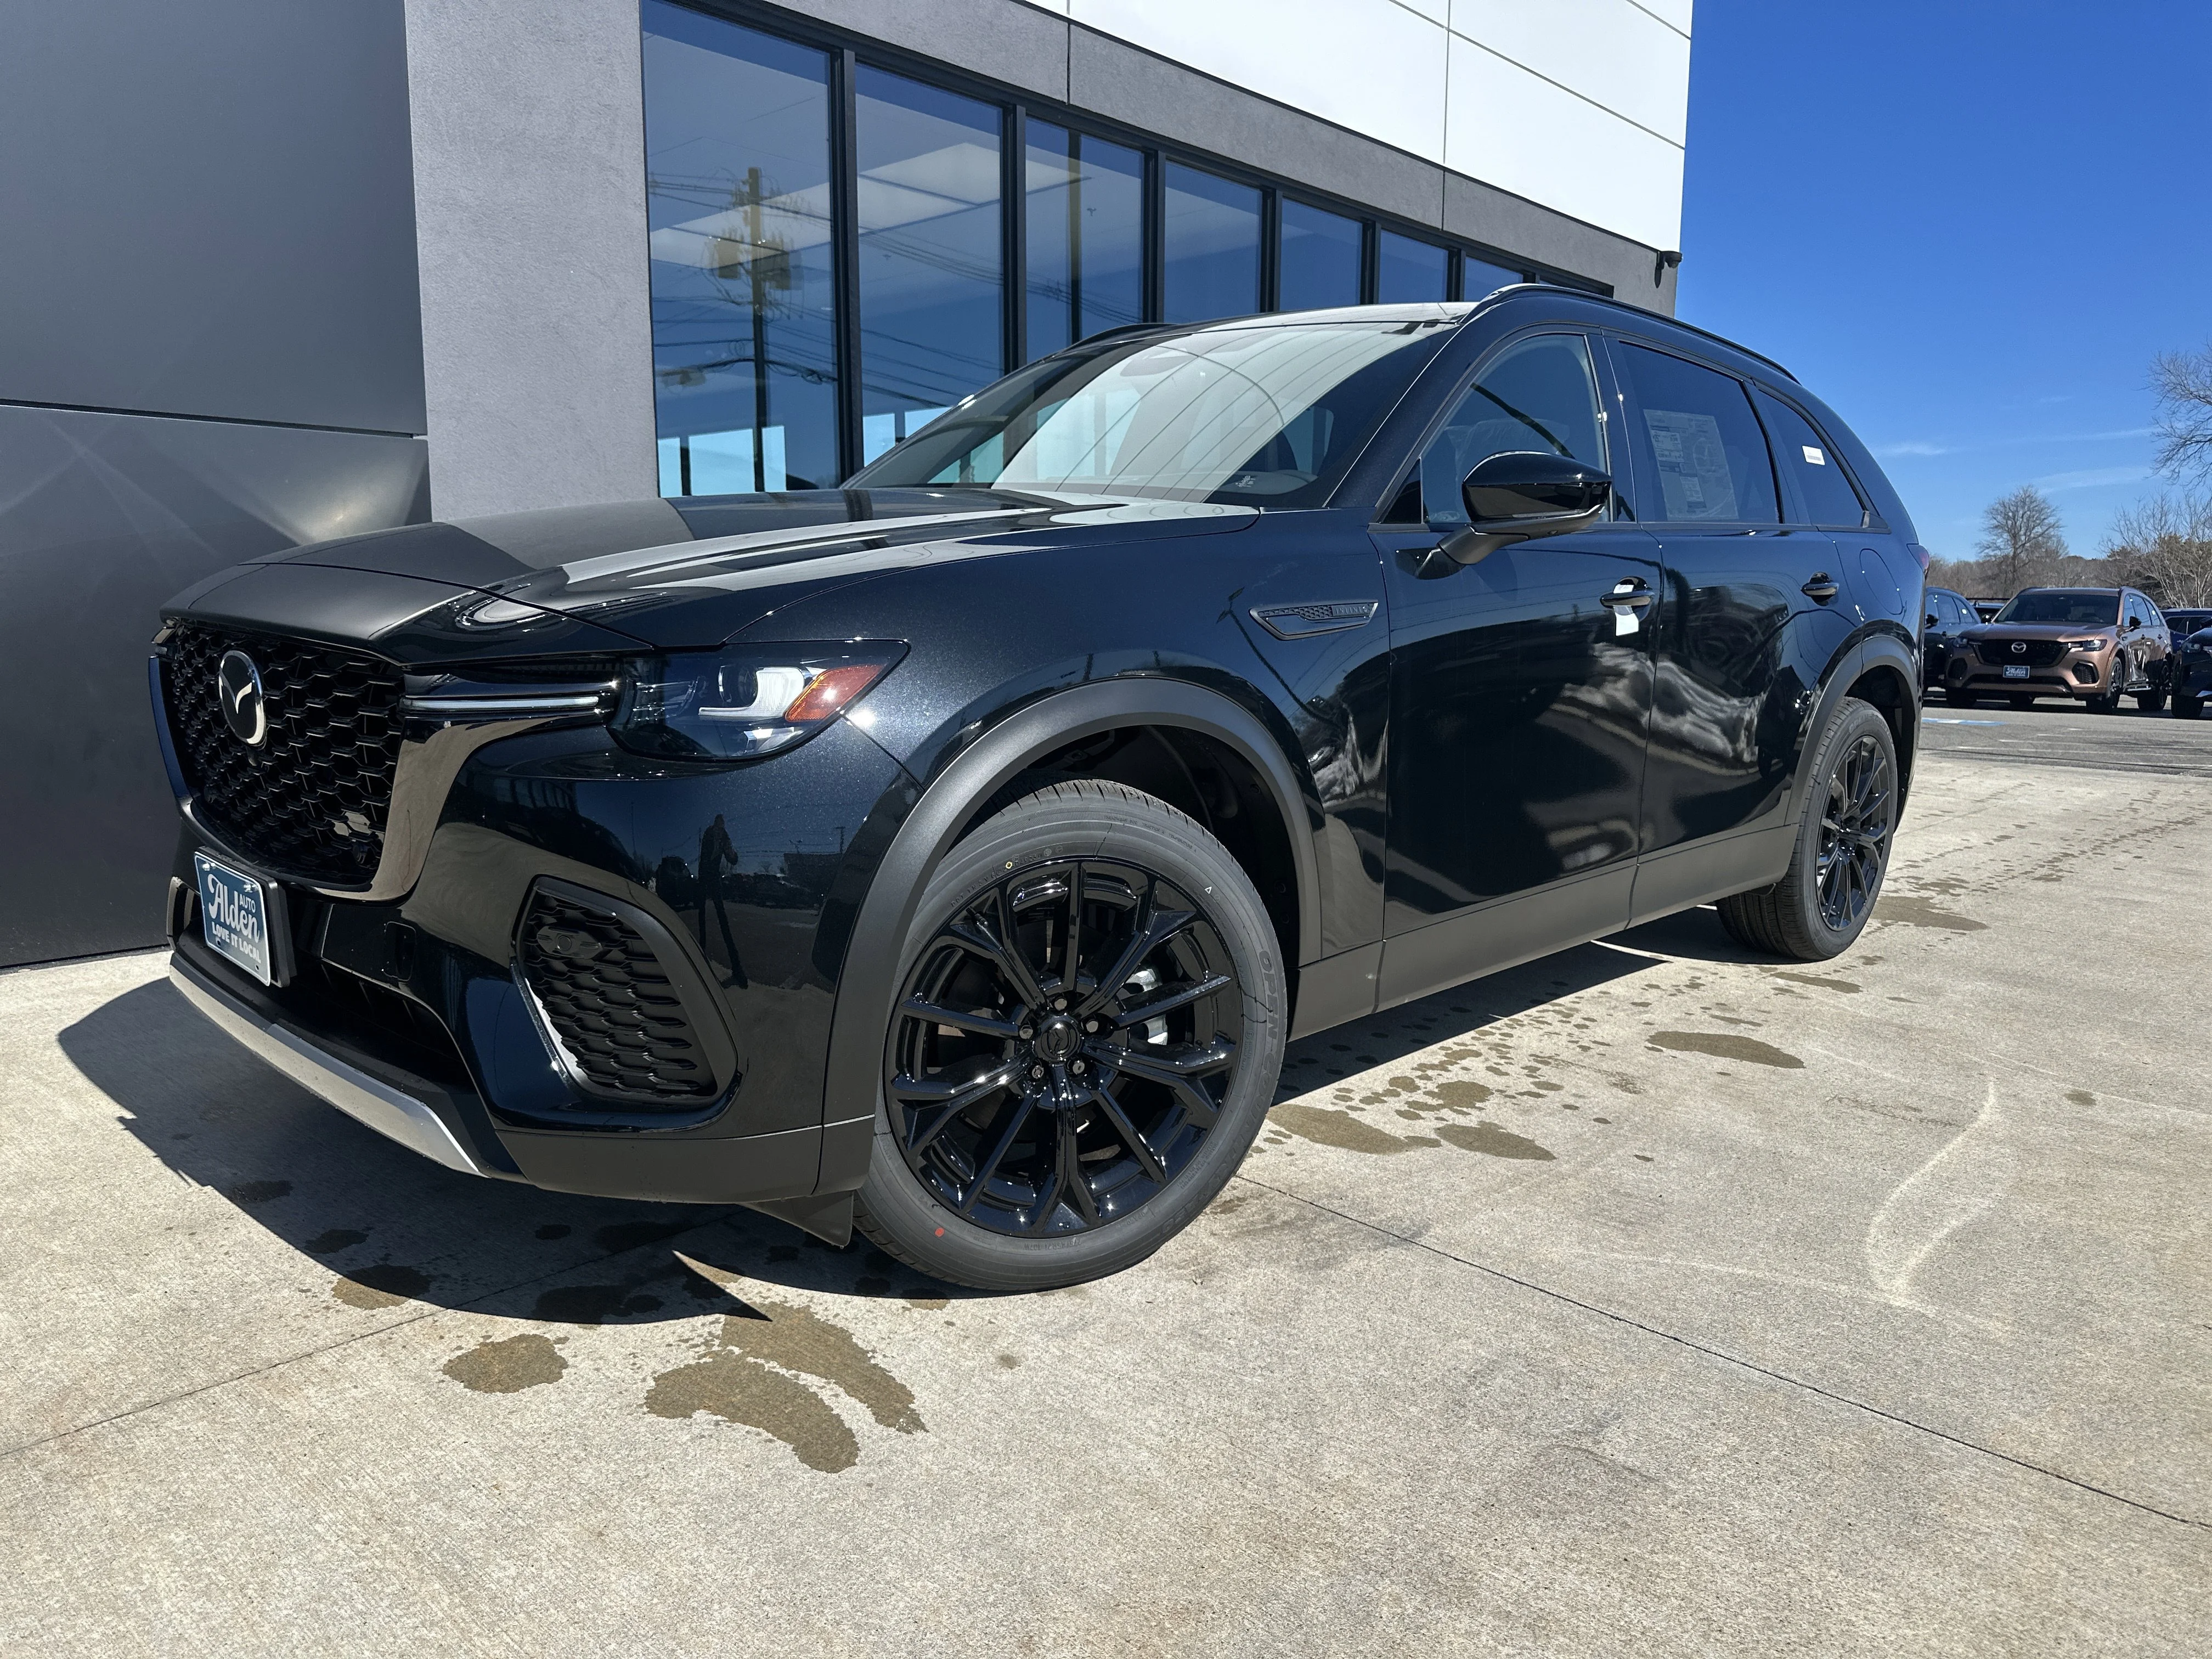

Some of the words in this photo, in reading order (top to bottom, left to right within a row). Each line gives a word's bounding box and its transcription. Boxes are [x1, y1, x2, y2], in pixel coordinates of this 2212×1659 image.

[207, 873, 260, 943] Alden
[240, 894, 256, 913] AUTO
[212, 922, 230, 943] LOVE
[231, 933, 238, 947] IT
[239, 938, 261, 963] LOCAL
[1259, 950, 1278, 1040] OPEN
